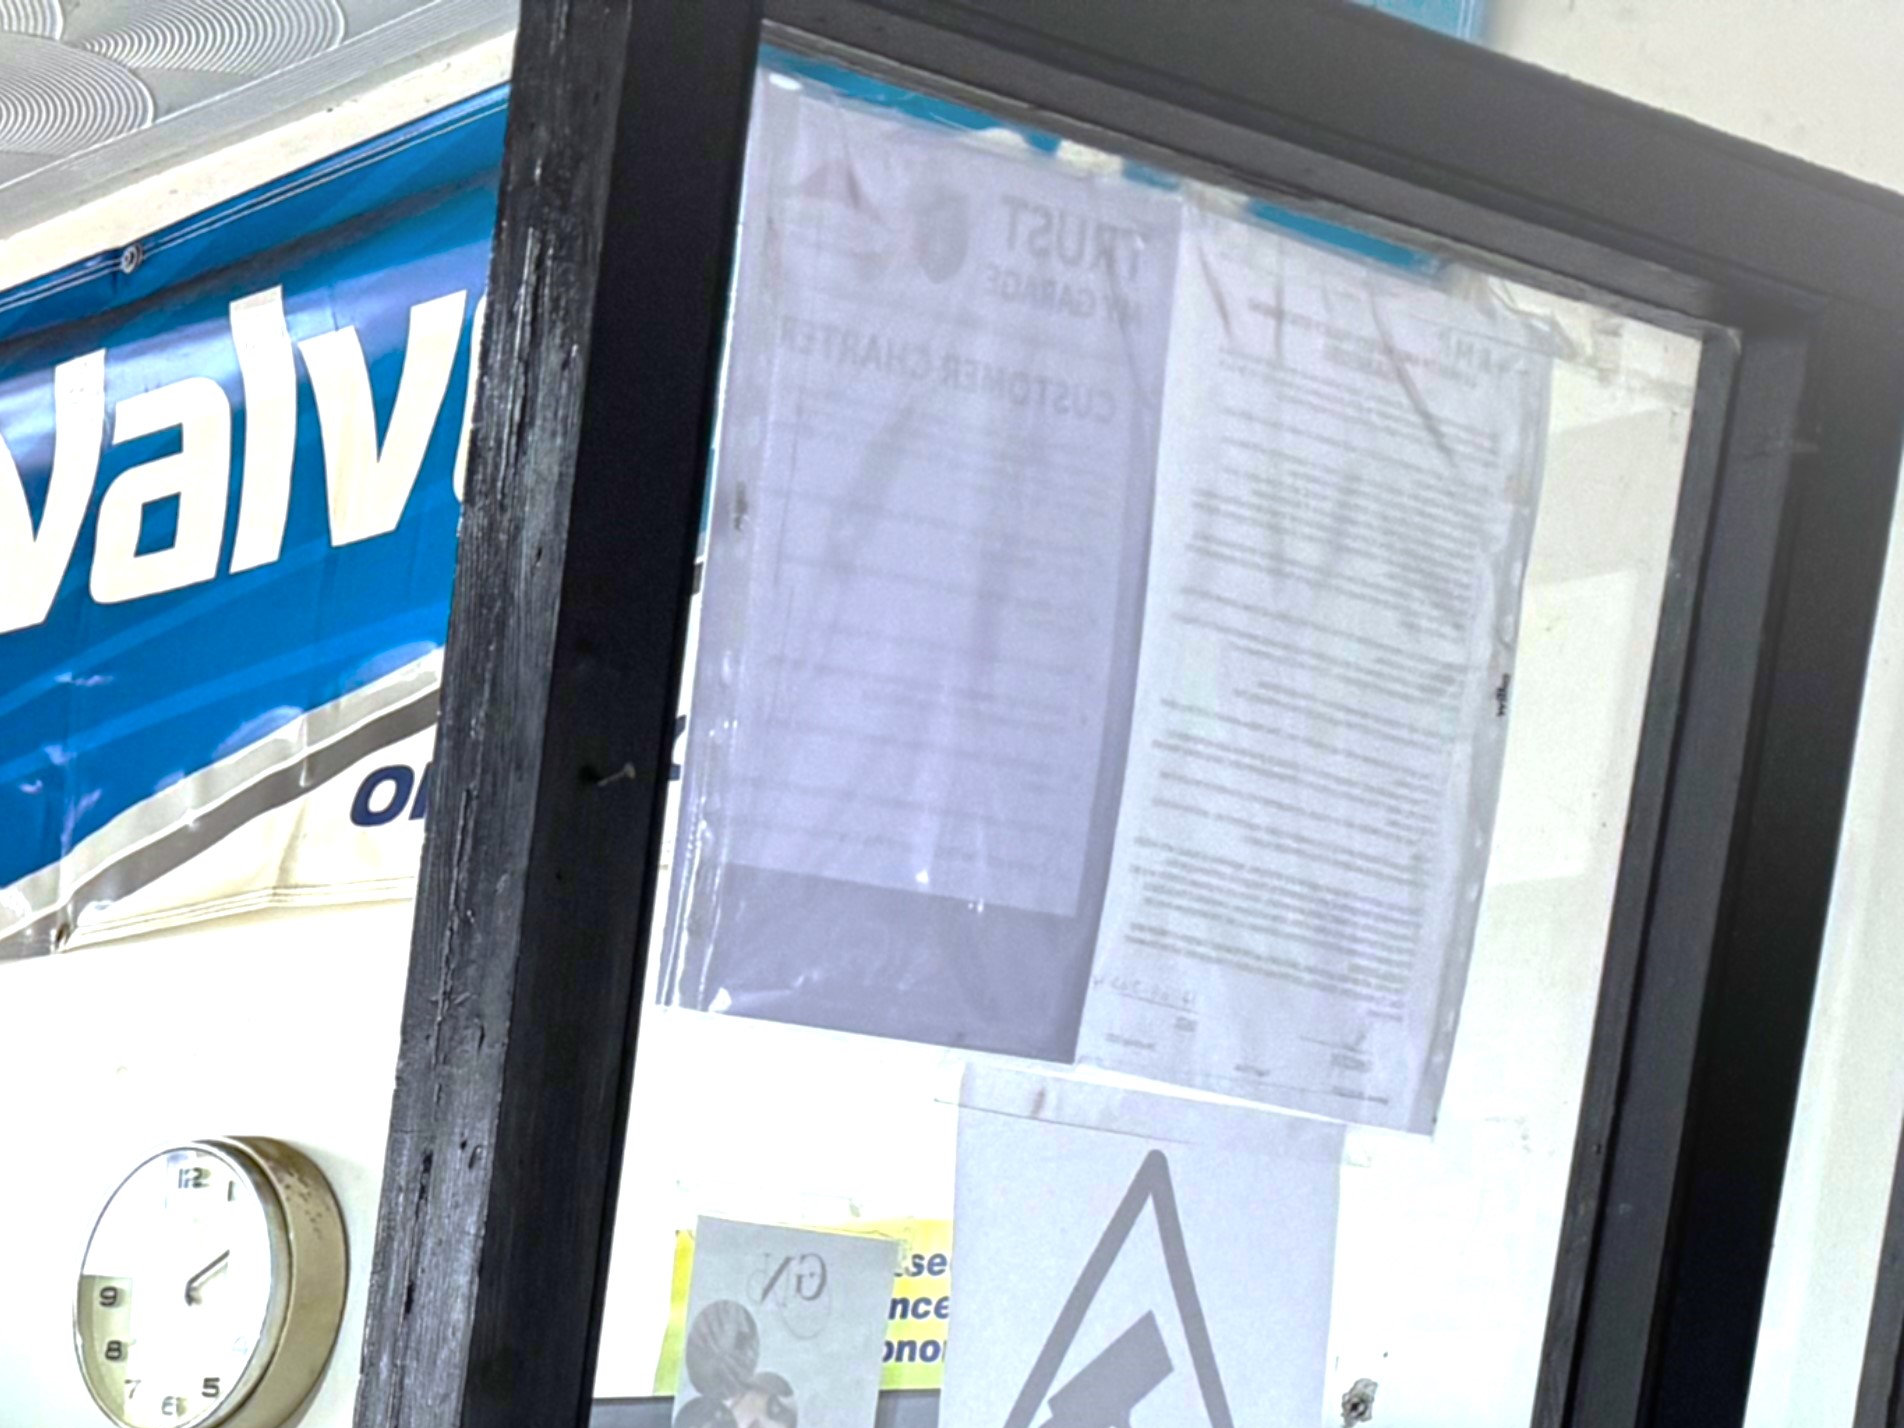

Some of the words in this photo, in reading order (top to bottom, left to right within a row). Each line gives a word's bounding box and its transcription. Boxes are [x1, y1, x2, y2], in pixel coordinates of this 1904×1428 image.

[98, 1286, 118, 1307] 9
[103, 1340, 123, 1360] 8
[202, 1378, 222, 1399] 5
